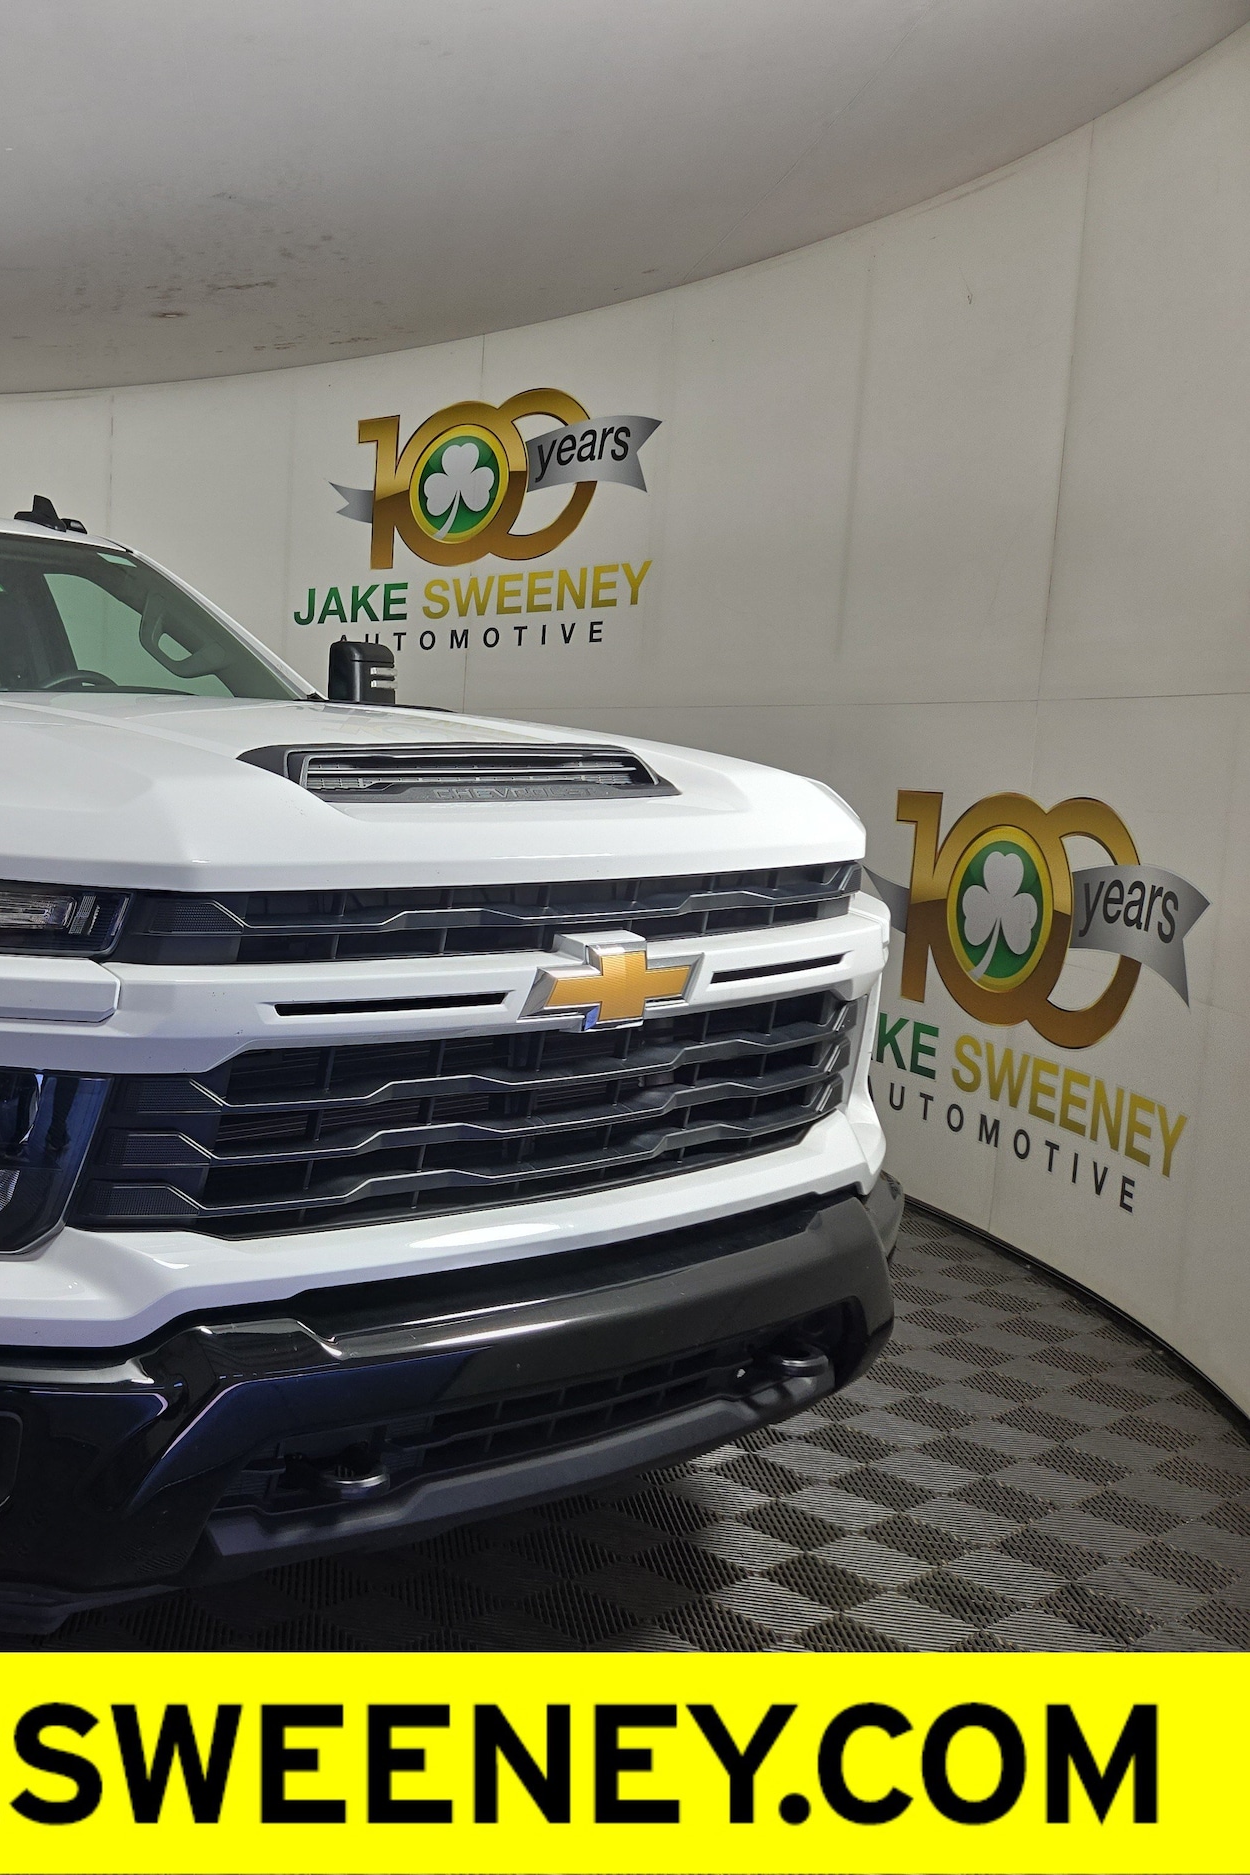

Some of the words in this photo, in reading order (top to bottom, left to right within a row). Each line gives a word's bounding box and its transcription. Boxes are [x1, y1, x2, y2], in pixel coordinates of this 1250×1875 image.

[358, 387, 597, 570] 100
[535, 426, 631, 483] years
[293, 581, 408, 626] JAKE
[422, 560, 653, 620] SWEENEY
[896, 789, 1142, 1050] 100
[1078, 877, 1180, 944] years
[871, 1011, 940, 1081] KE
[952, 1034, 1189, 1179] SWEENEY
